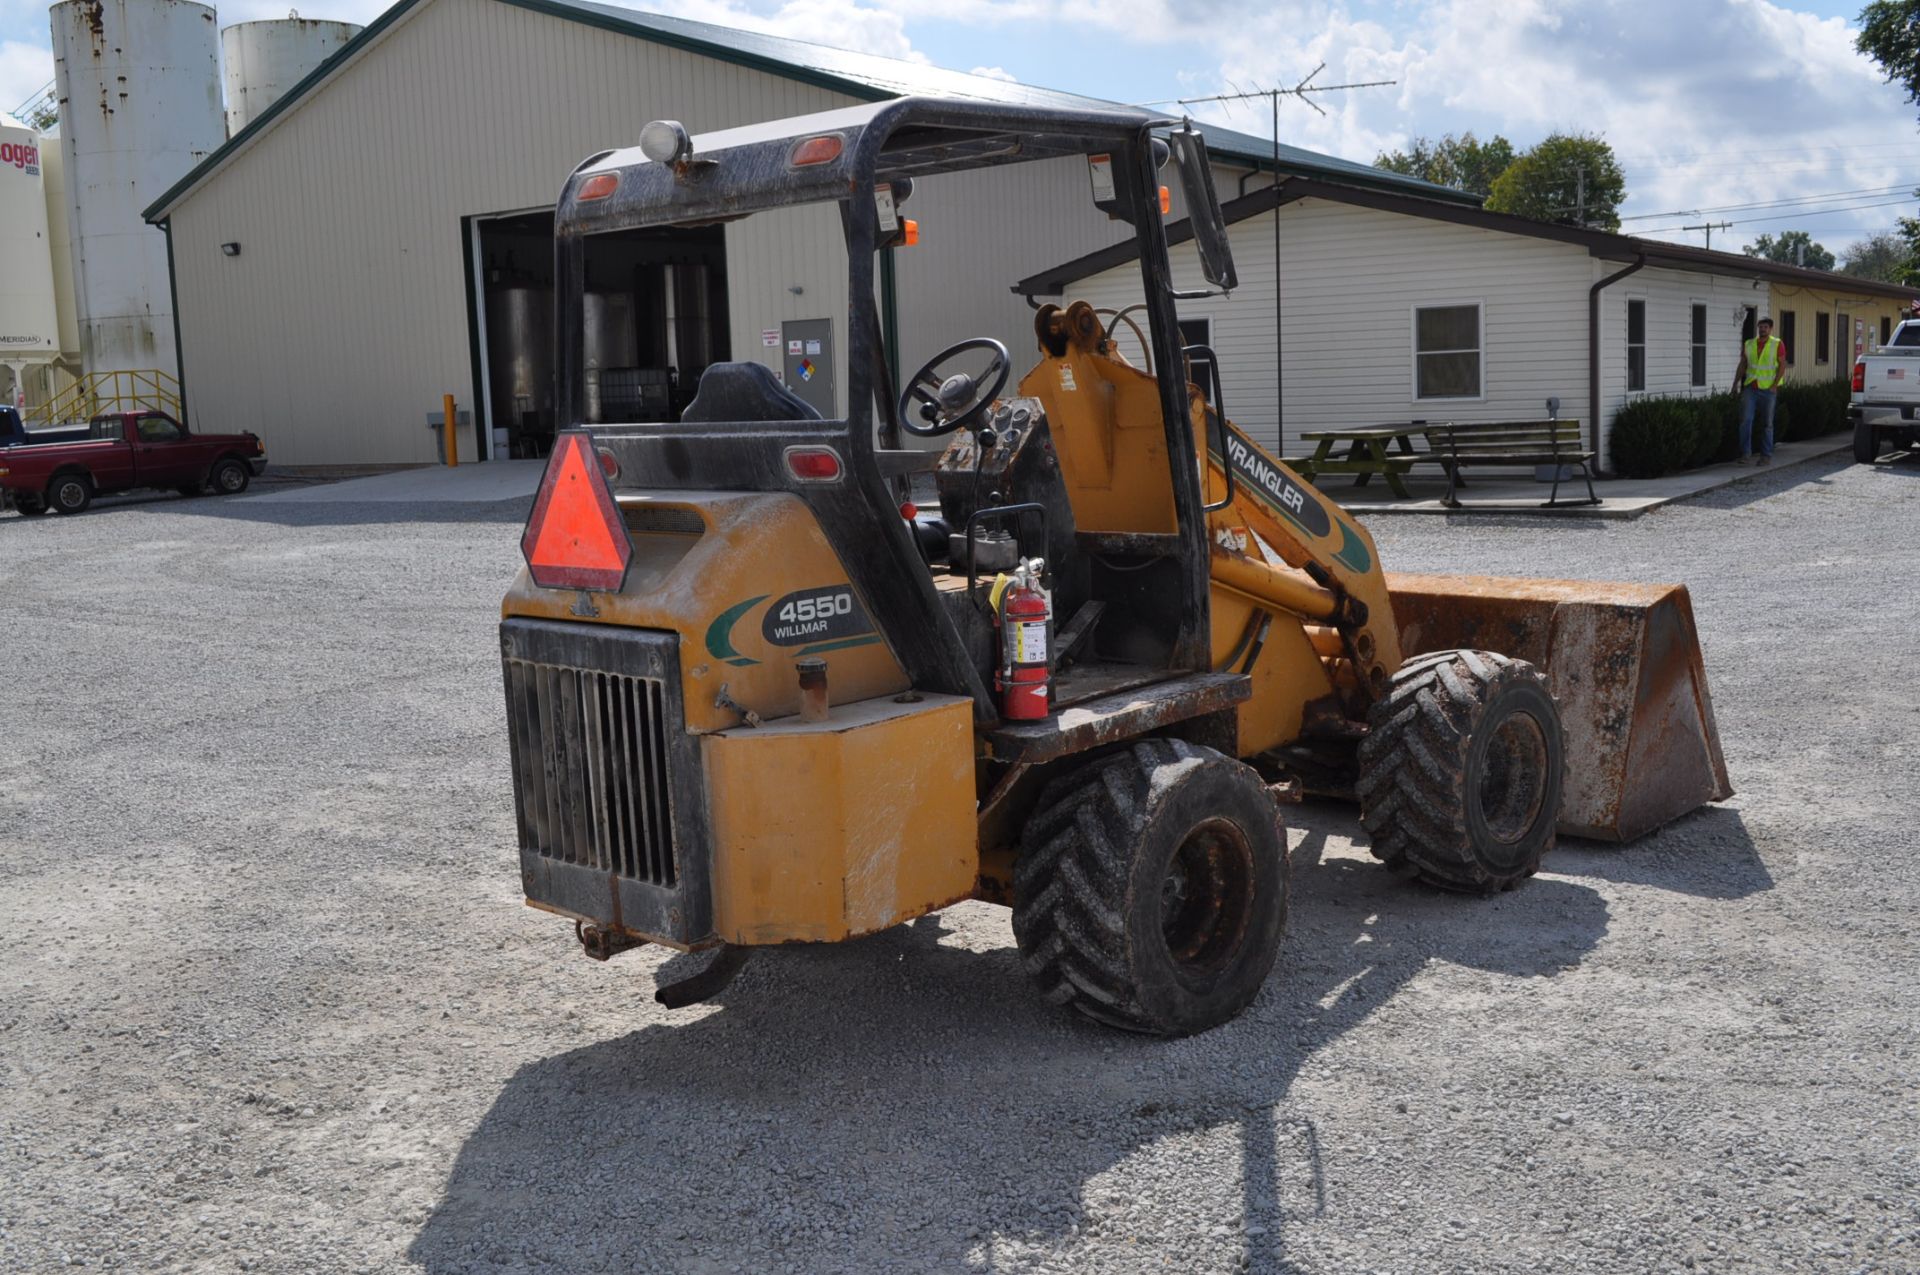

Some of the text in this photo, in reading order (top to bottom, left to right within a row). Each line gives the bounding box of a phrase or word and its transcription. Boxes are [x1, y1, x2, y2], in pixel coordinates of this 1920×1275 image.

[0, 143, 39, 169] ogen
[779, 593, 852, 623] 4550
[774, 620, 828, 639] WILLMAR
